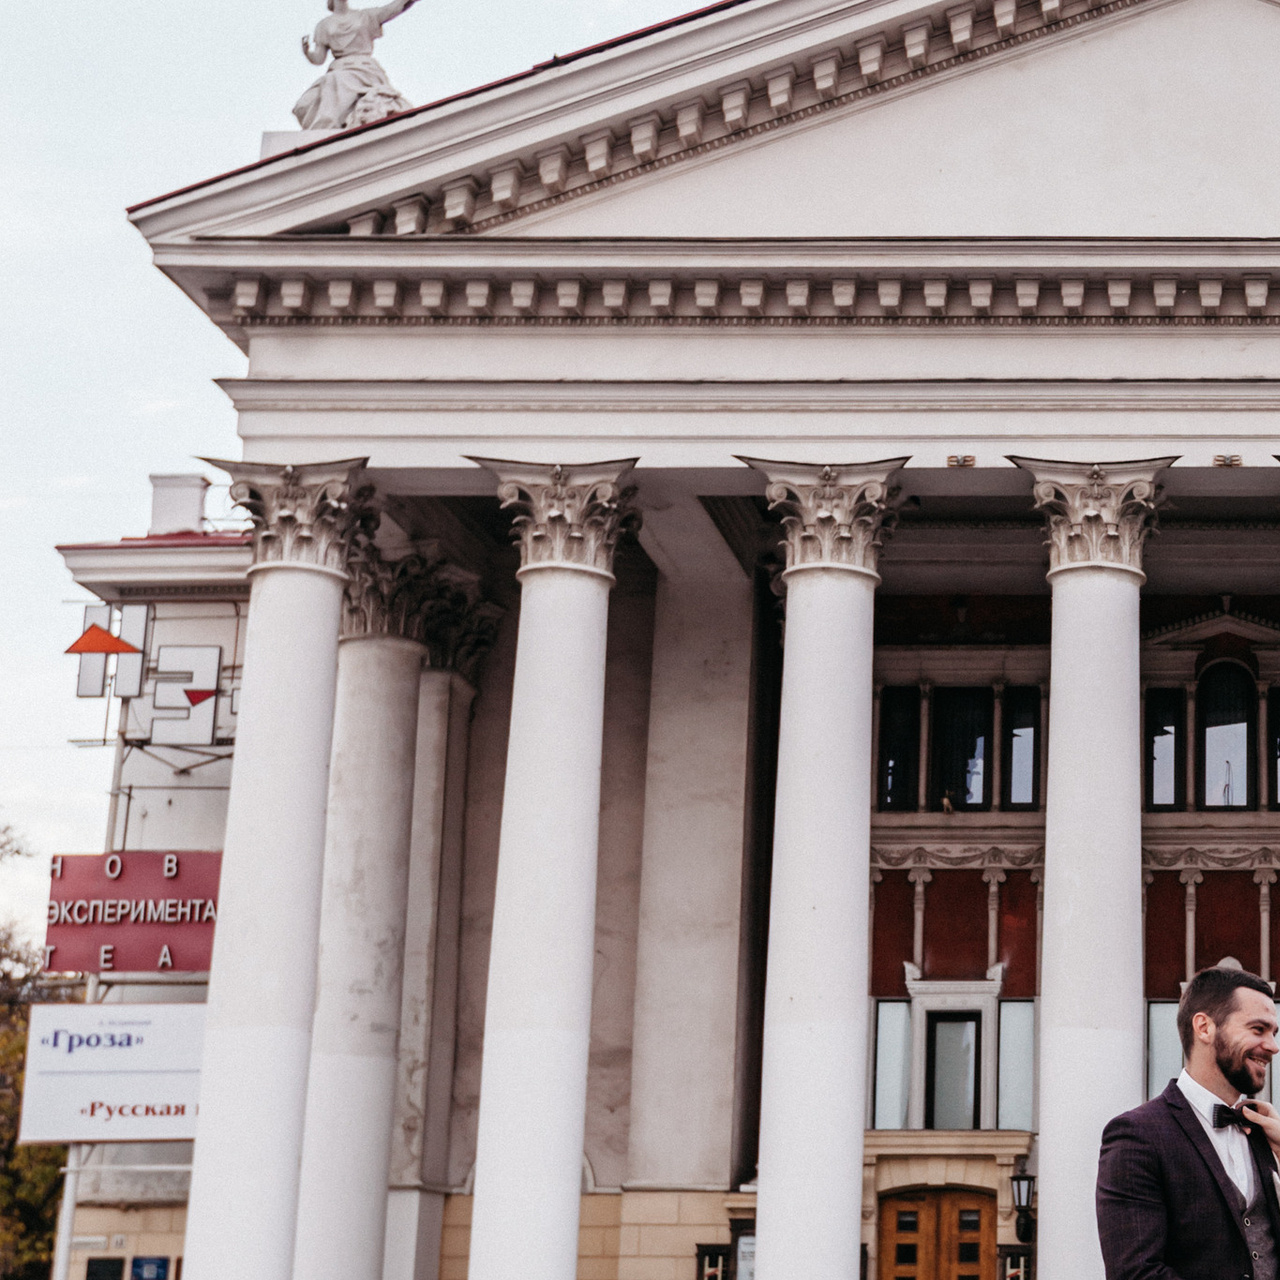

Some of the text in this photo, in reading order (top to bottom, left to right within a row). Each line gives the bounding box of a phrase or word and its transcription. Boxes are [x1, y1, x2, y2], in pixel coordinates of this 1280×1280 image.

[48, 898, 218, 924] ЭКСПЕРИМЕНТА
[41, 1029, 144, 1053] «Гроза»
[80, 1101, 186, 1121] «Русская
